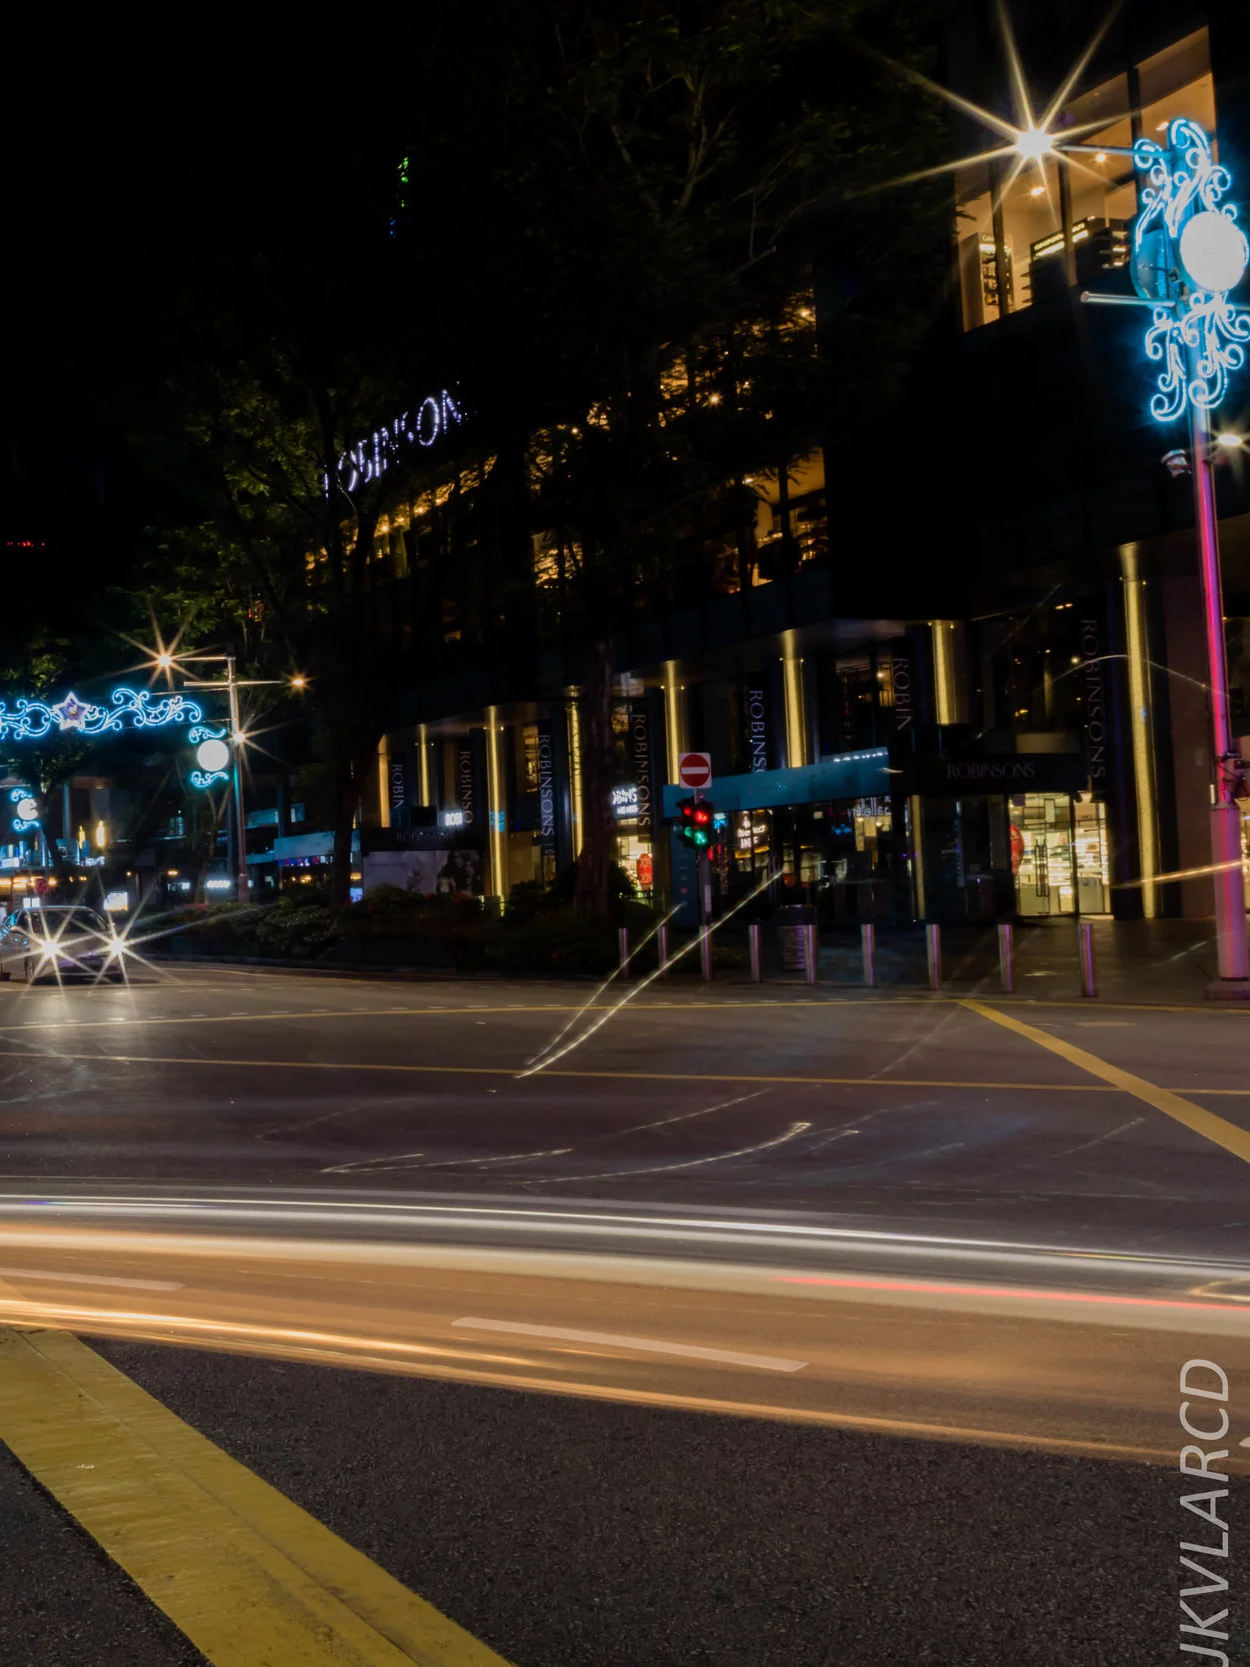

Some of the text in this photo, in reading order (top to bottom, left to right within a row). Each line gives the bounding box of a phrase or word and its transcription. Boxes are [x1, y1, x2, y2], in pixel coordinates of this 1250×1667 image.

[749, 689, 768, 774] ROBINS
[1080, 619, 1107, 778] ROBINSONS
[539, 734, 554, 837] ROBINSONS
[633, 713, 650, 827] ROBINSONS
[946, 762, 1035, 779] ROBINSONS
